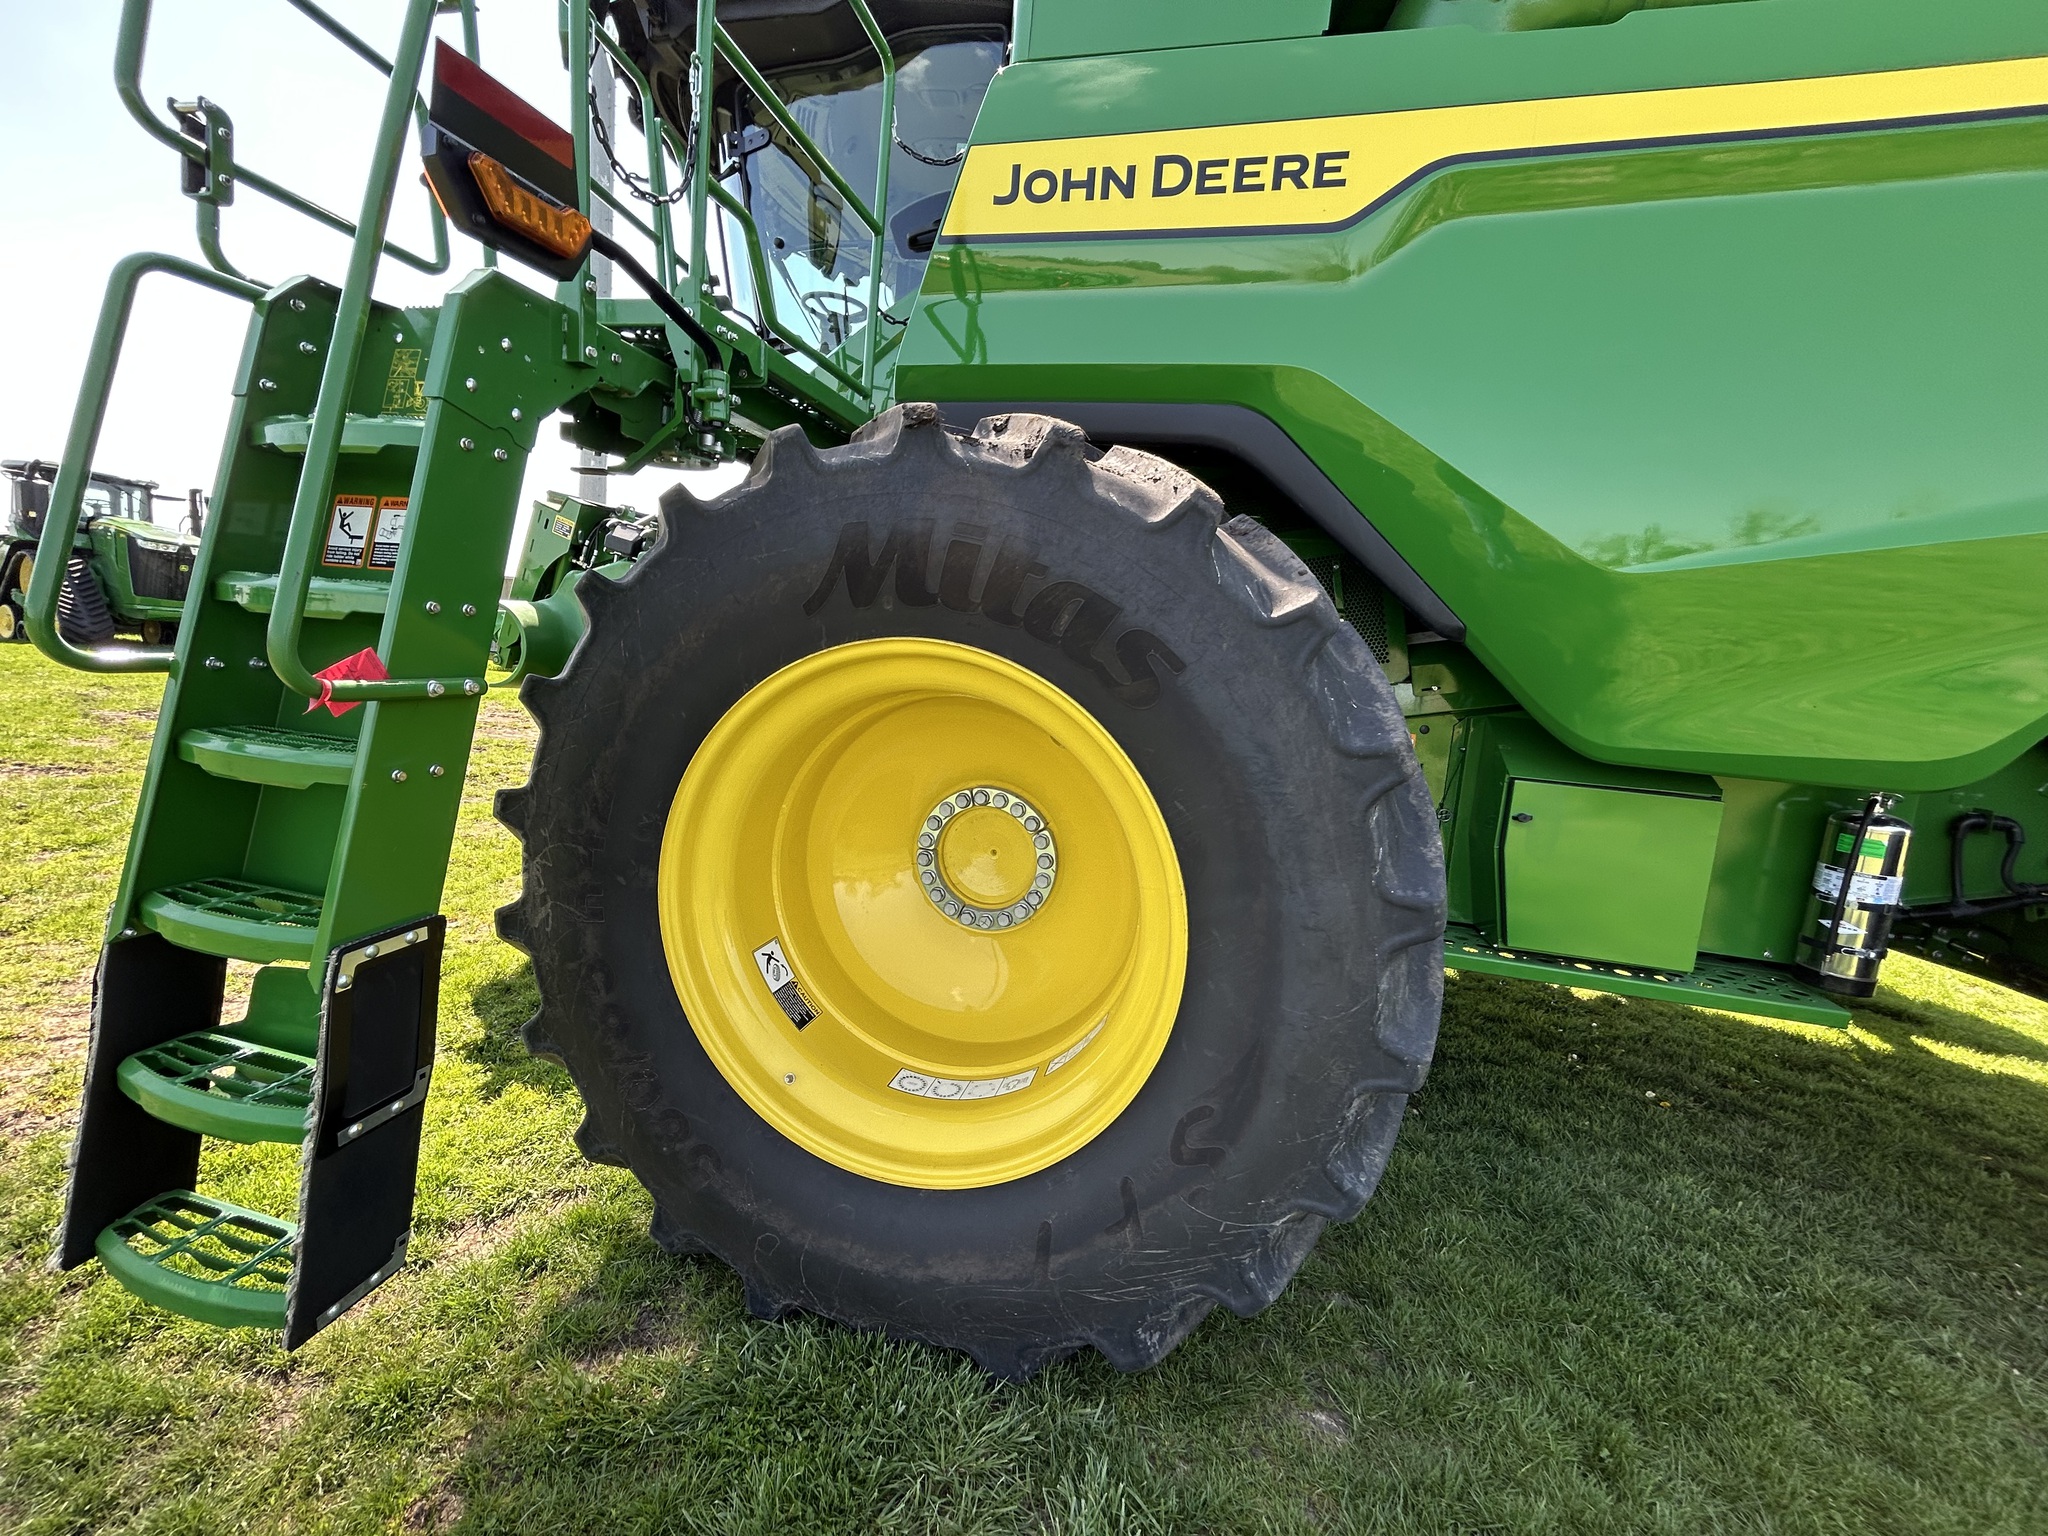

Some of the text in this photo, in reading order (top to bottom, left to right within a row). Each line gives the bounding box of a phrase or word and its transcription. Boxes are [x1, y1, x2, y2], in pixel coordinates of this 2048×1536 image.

[992, 150, 1350, 206] JOHN DEERE
[344, 497, 375, 506] WARNING
[390, 499, 409, 507] WARN
[802, 517, 1187, 710] Mitas
[797, 987, 820, 1015] CAUTION
